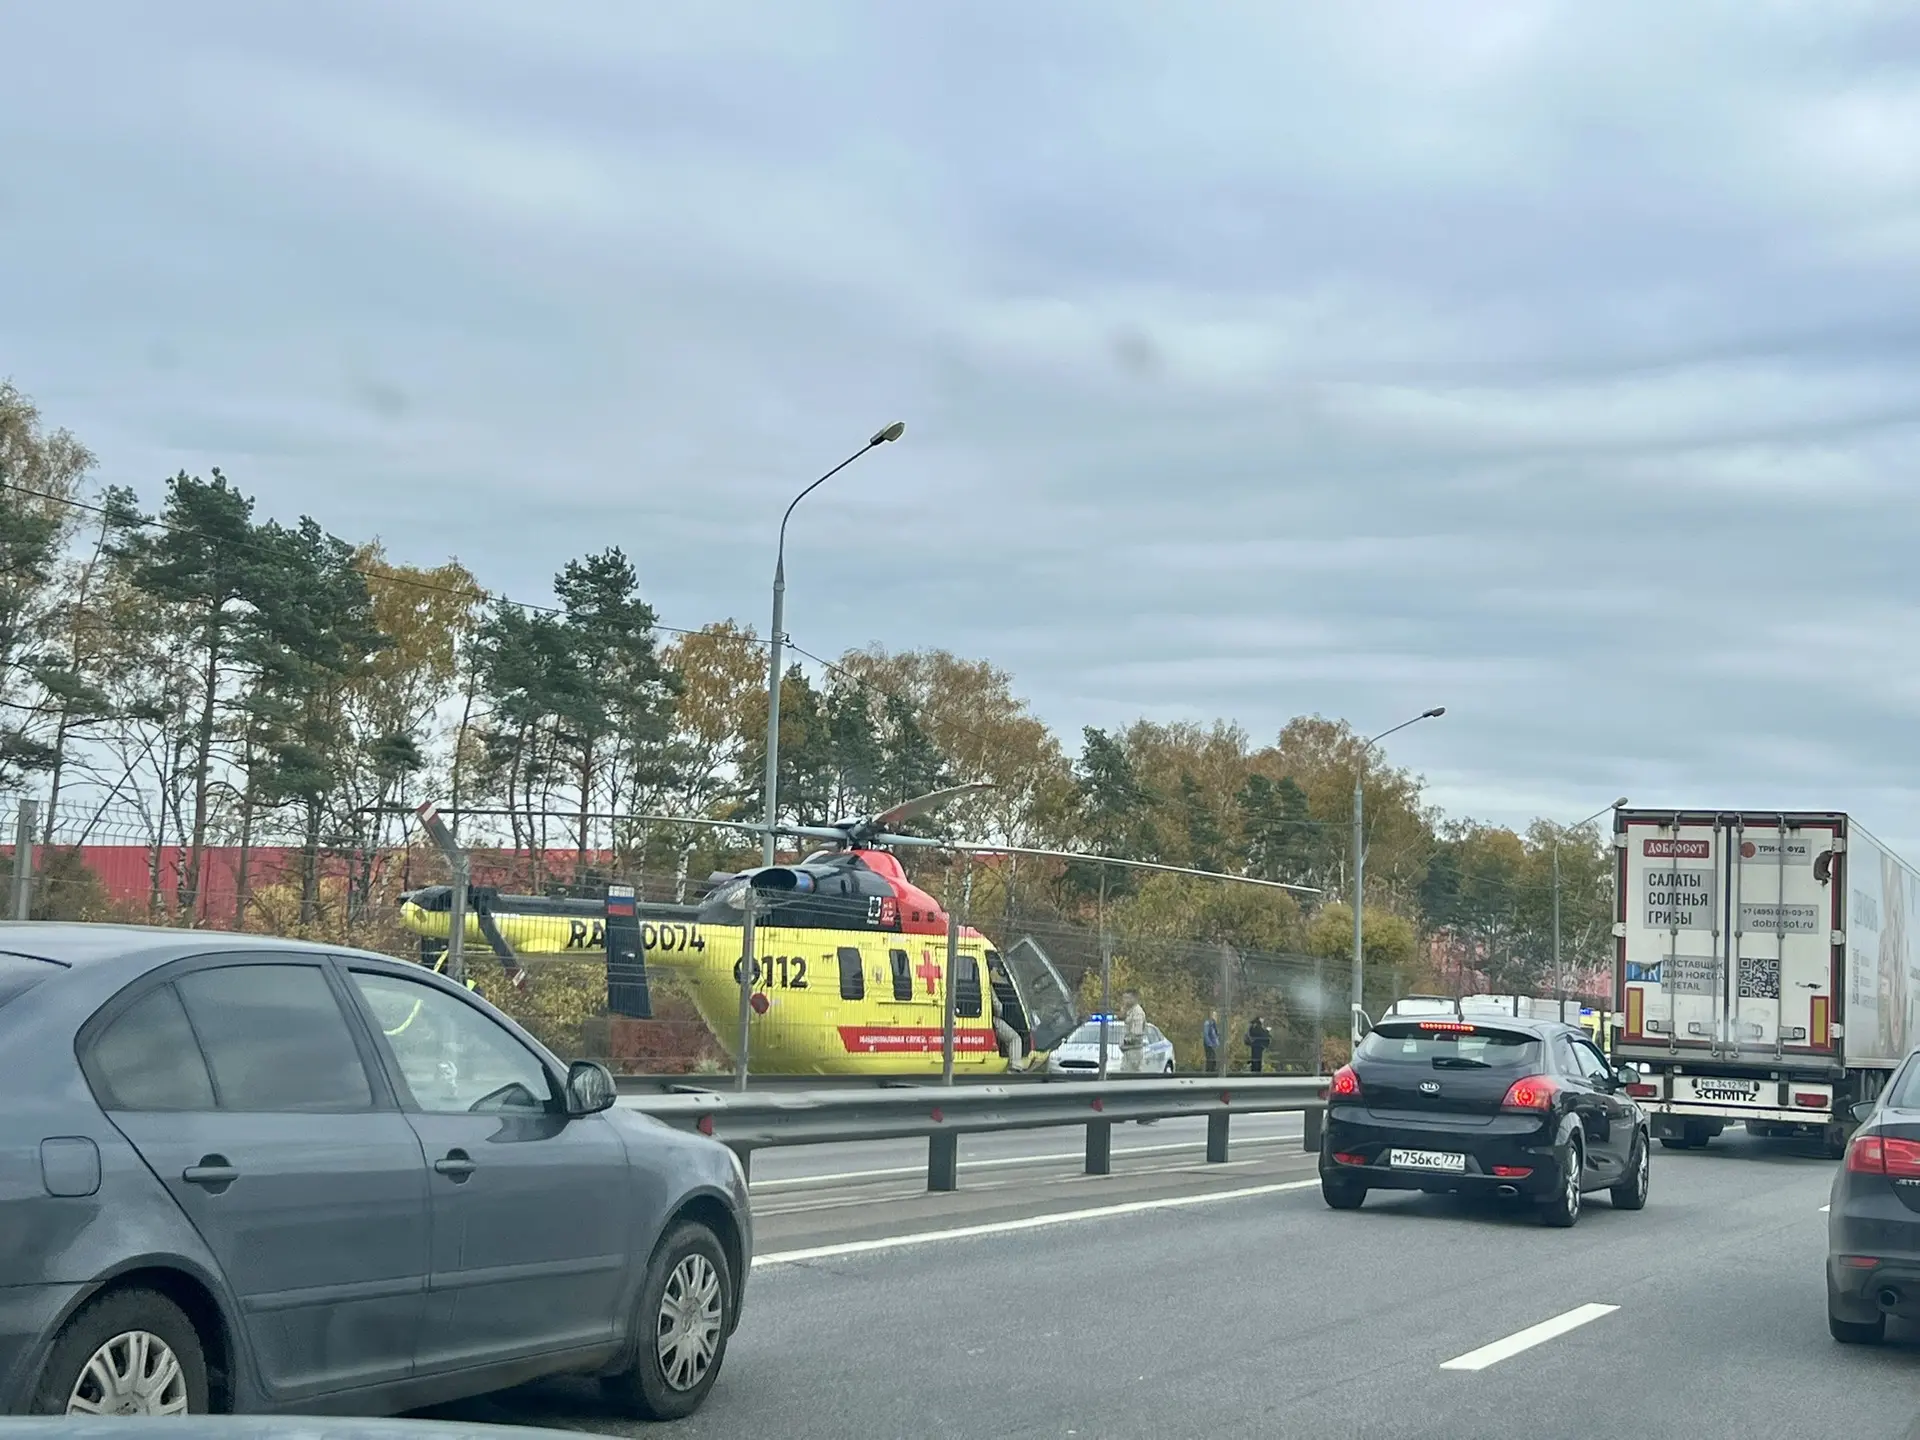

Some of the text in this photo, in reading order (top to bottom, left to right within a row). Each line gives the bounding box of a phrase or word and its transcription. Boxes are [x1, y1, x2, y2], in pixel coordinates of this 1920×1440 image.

[1647, 842, 1705, 854] ДОБРОСОТ
[1787, 845, 1806, 854] ФУД
[1648, 873, 1701, 887] САЛАТЫ
[1648, 892, 1708, 906] СОЛЕНЬЯ
[1648, 911, 1692, 925] ГРИБЫ
[1695, 1089, 1757, 1102] SCHMITZ
